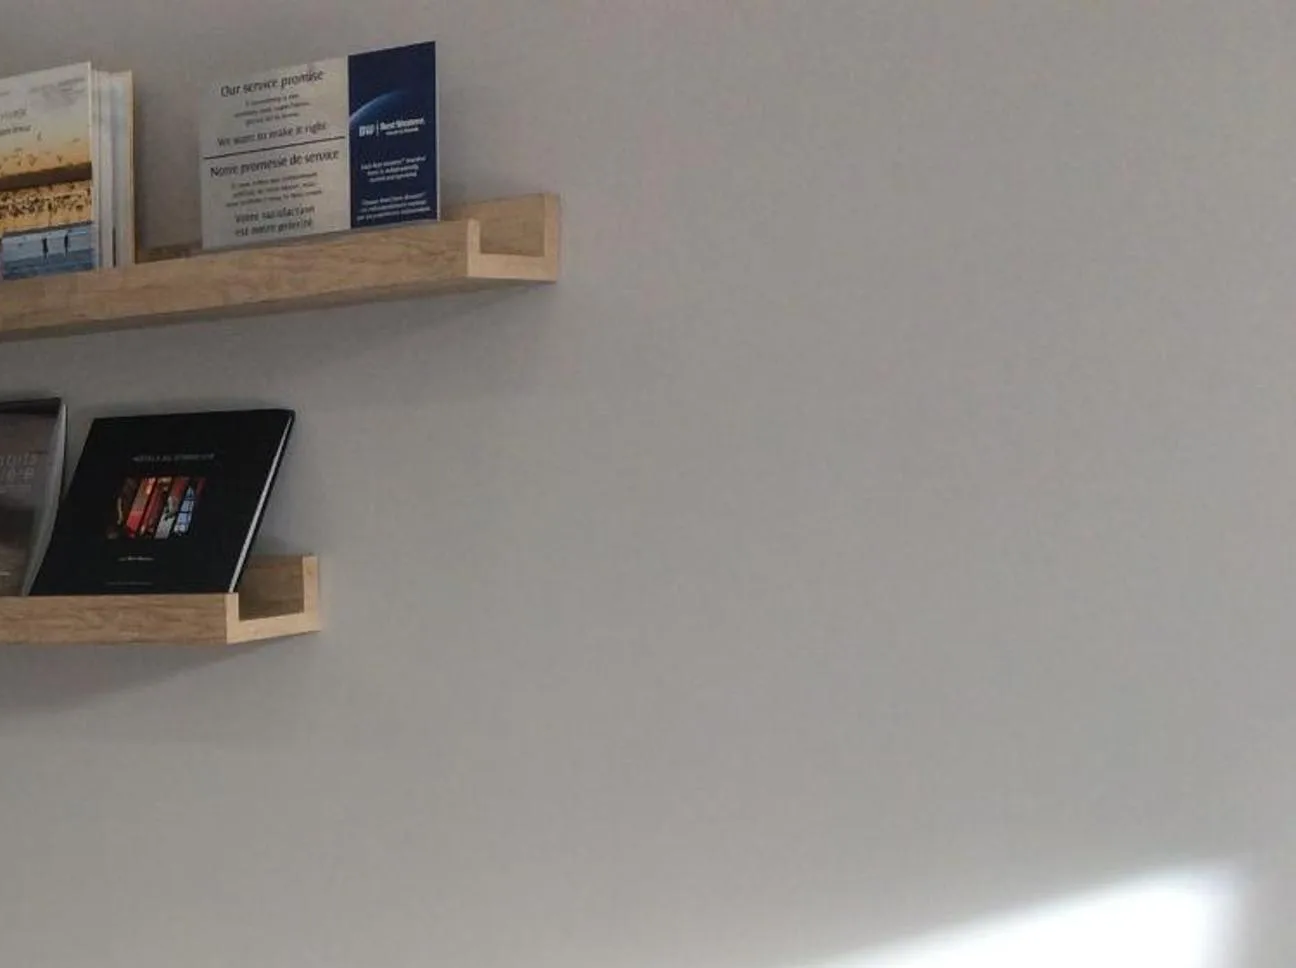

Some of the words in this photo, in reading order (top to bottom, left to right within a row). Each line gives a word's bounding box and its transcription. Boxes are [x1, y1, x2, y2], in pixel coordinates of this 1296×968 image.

[219, 84, 241, 98] Our
[242, 79, 278, 93] service
[280, 69, 324, 89] promise
[217, 136, 231, 148] We
[268, 125, 293, 140] make
[305, 120, 327, 136] right
[210, 164, 239, 179] Notre
[240, 157, 289, 175] promesse
[290, 152, 304, 166] de
[305, 148, 340, 163] service
